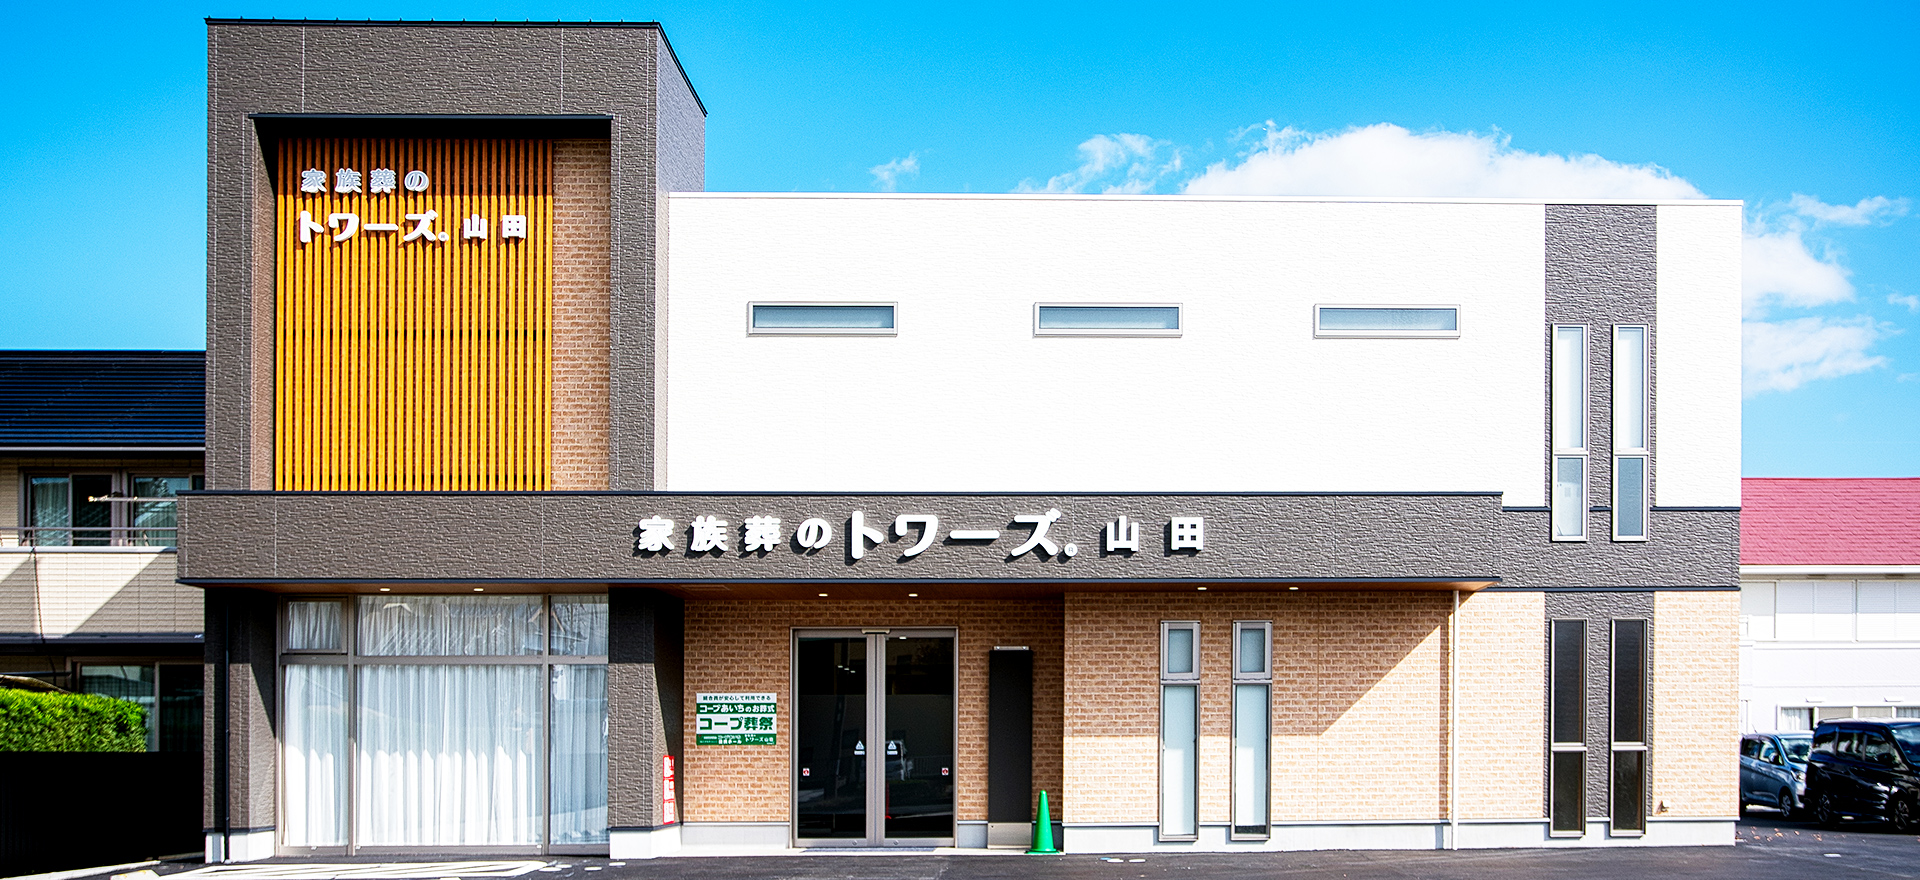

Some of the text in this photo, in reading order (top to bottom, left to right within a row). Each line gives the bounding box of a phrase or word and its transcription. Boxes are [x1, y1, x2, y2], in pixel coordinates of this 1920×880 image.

[301, 168, 430, 193] 家族葬の
[700, 704, 774, 713] コープあいちのお葬式
[700, 716, 773, 730] コープ葬祭
